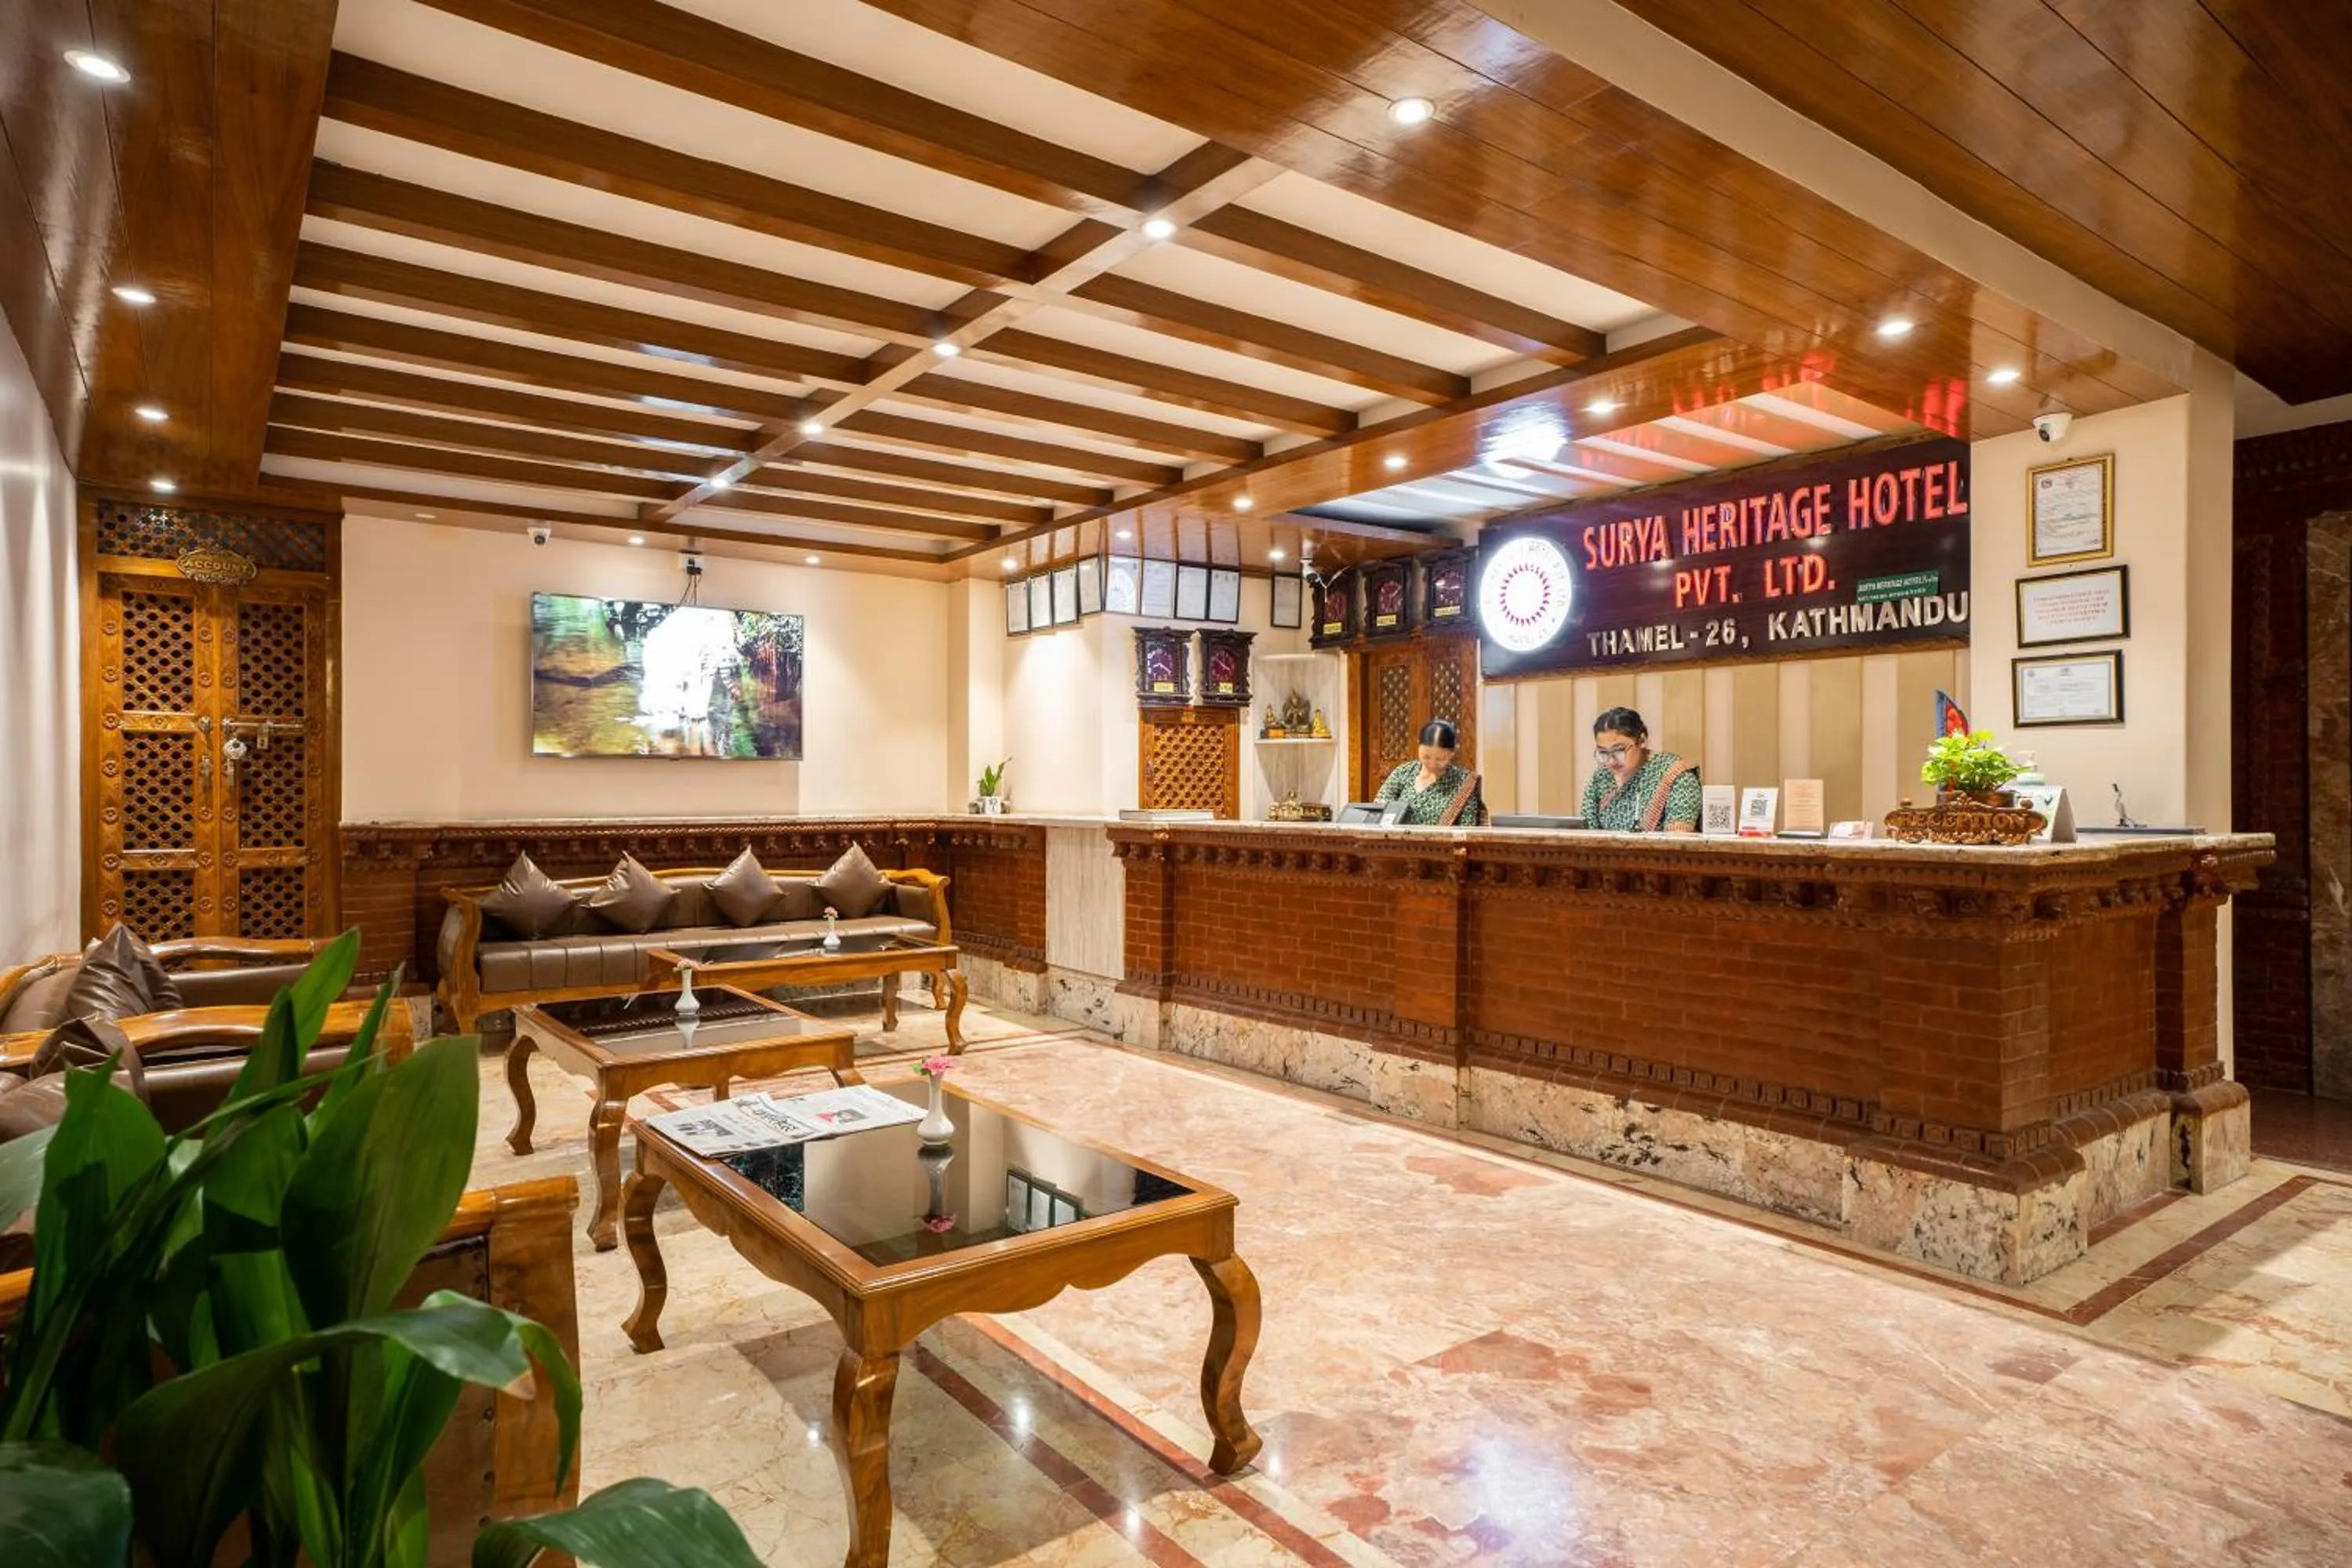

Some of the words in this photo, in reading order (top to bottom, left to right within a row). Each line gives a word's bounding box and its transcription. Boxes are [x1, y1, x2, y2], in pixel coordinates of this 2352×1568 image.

[1583, 515, 1671, 570] SURYA
[1682, 484, 1832, 555] HERITAGE
[1848, 461, 1968, 530] HOTEL
[184, 559, 248, 573] ACCOUNT
[1675, 564, 1740, 608] PVT.
[1764, 553, 1836, 597] LTD.
[1768, 591, 1969, 641] KATHMANDU
[1900, 812, 2027, 829] RECEPTION
